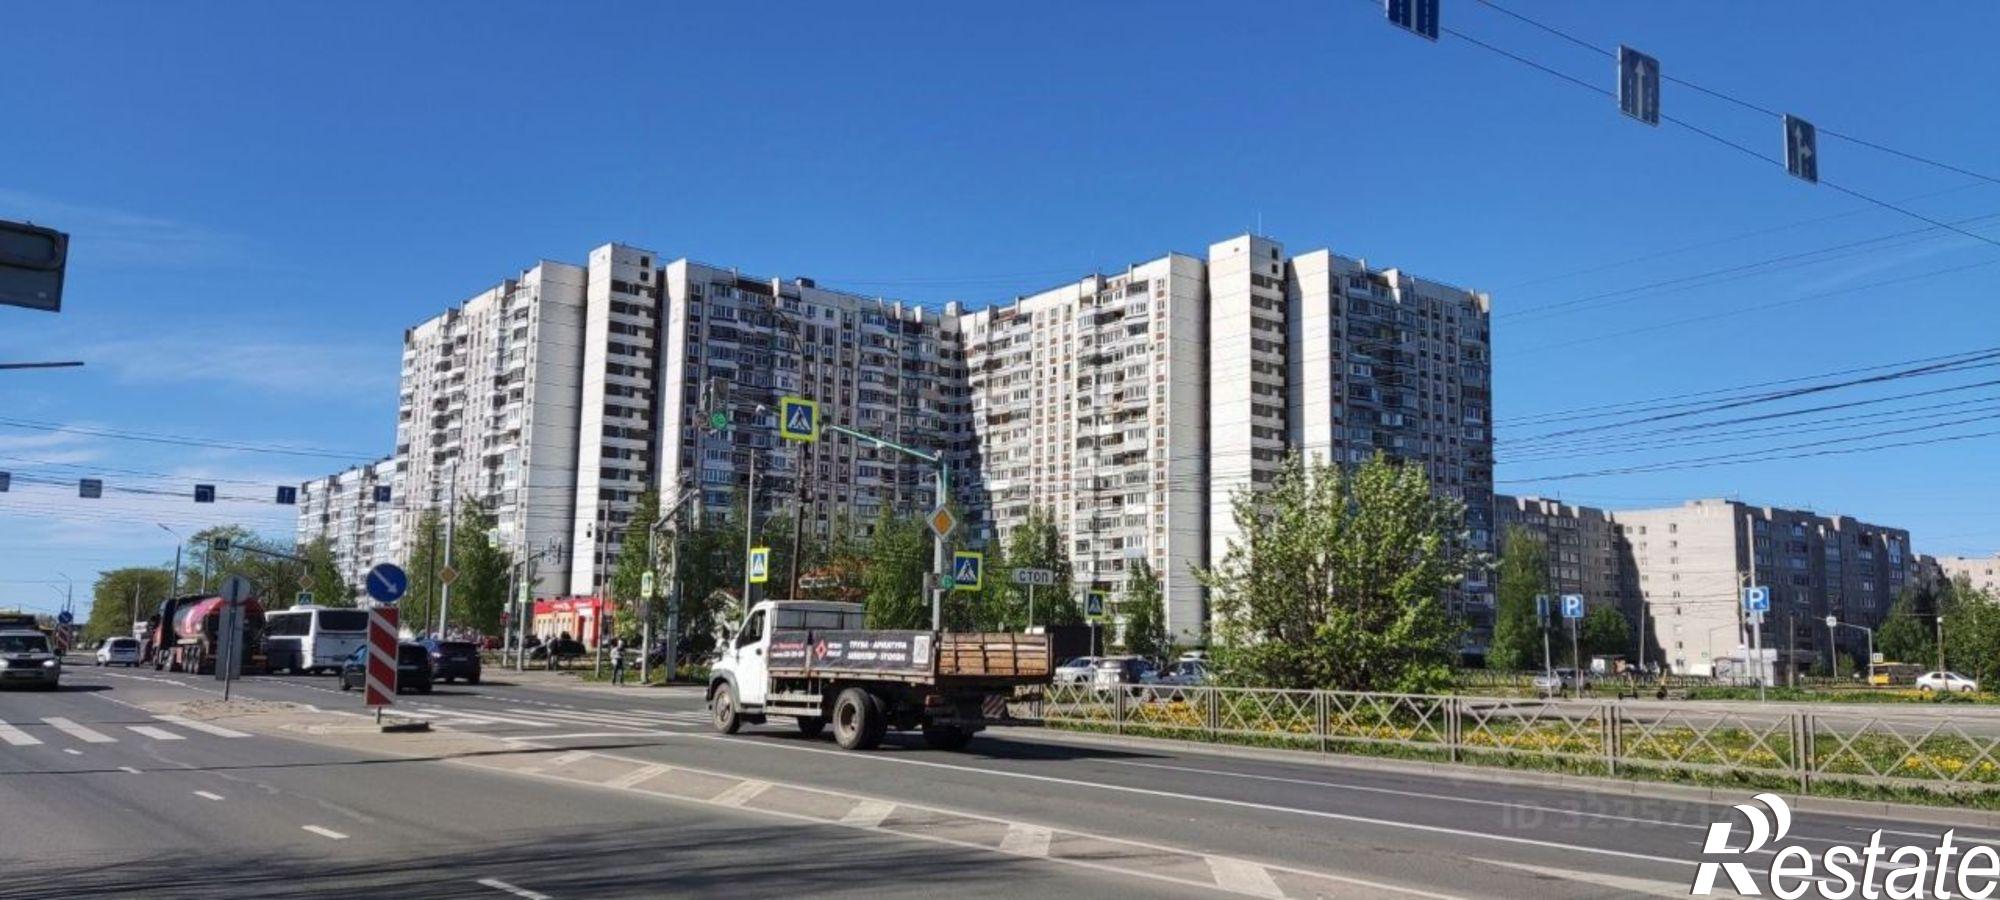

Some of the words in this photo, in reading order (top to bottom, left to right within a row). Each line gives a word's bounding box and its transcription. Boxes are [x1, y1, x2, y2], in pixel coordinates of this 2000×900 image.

[1019, 570, 1048, 583] СТОП
[1565, 596, 1579, 615] P
[1750, 589, 1764, 609] P
